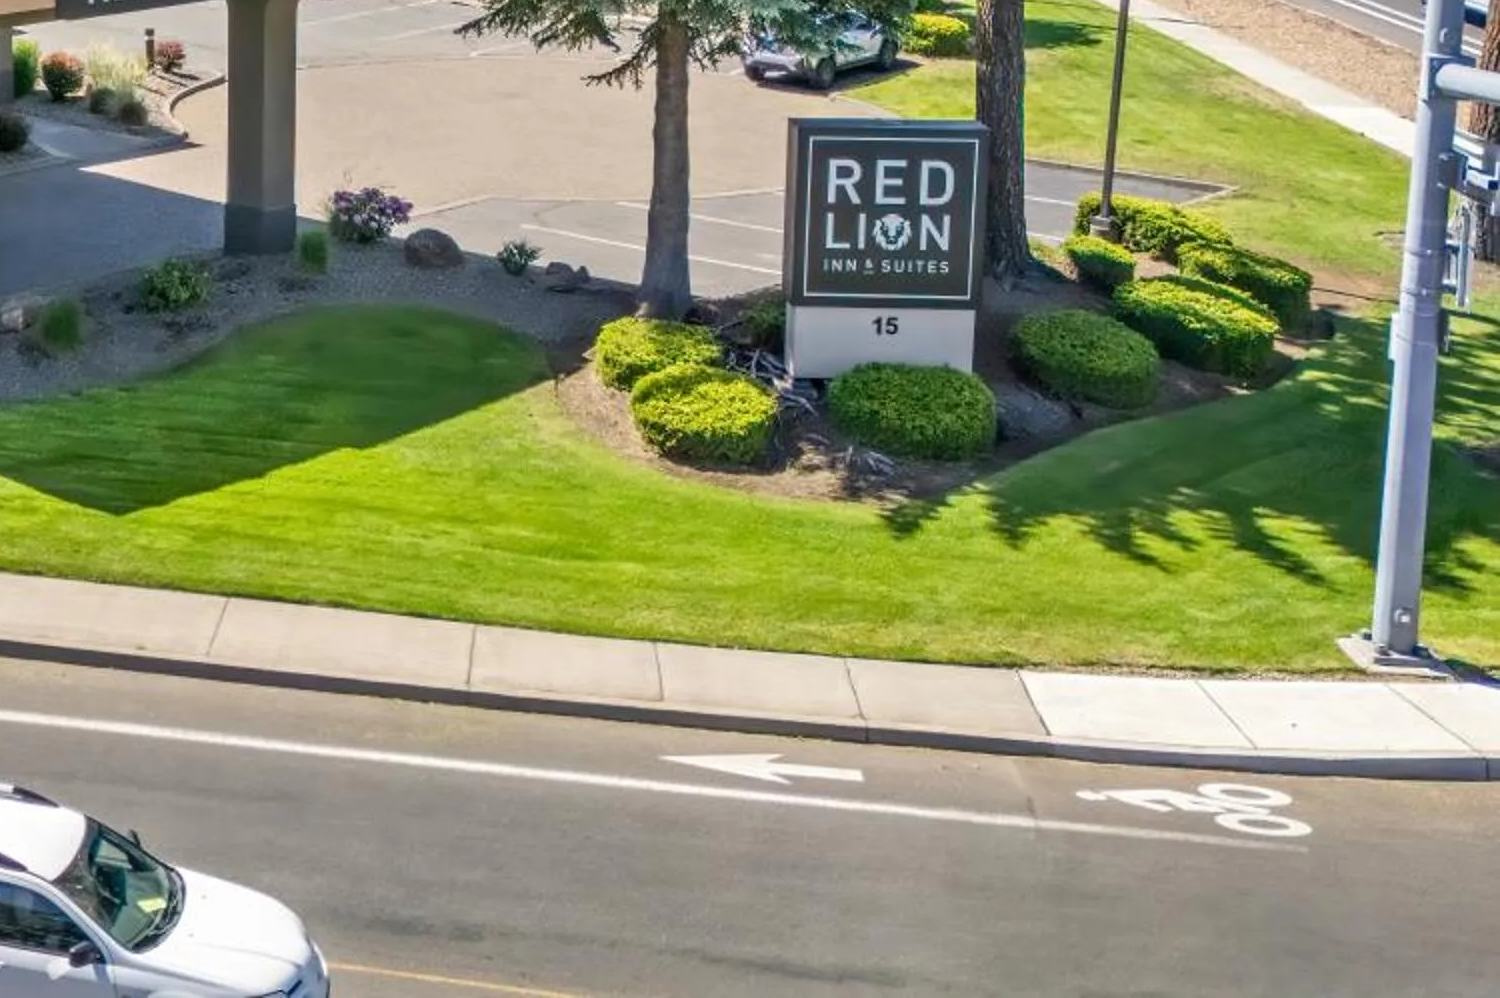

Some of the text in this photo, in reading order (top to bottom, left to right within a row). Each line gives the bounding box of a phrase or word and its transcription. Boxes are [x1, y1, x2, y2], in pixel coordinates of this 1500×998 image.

[827, 159, 955, 206] RED
[825, 212, 951, 251] LION
[823, 258, 857, 273] INN
[881, 259, 949, 273] SUITES
[872, 317, 899, 335] 15
